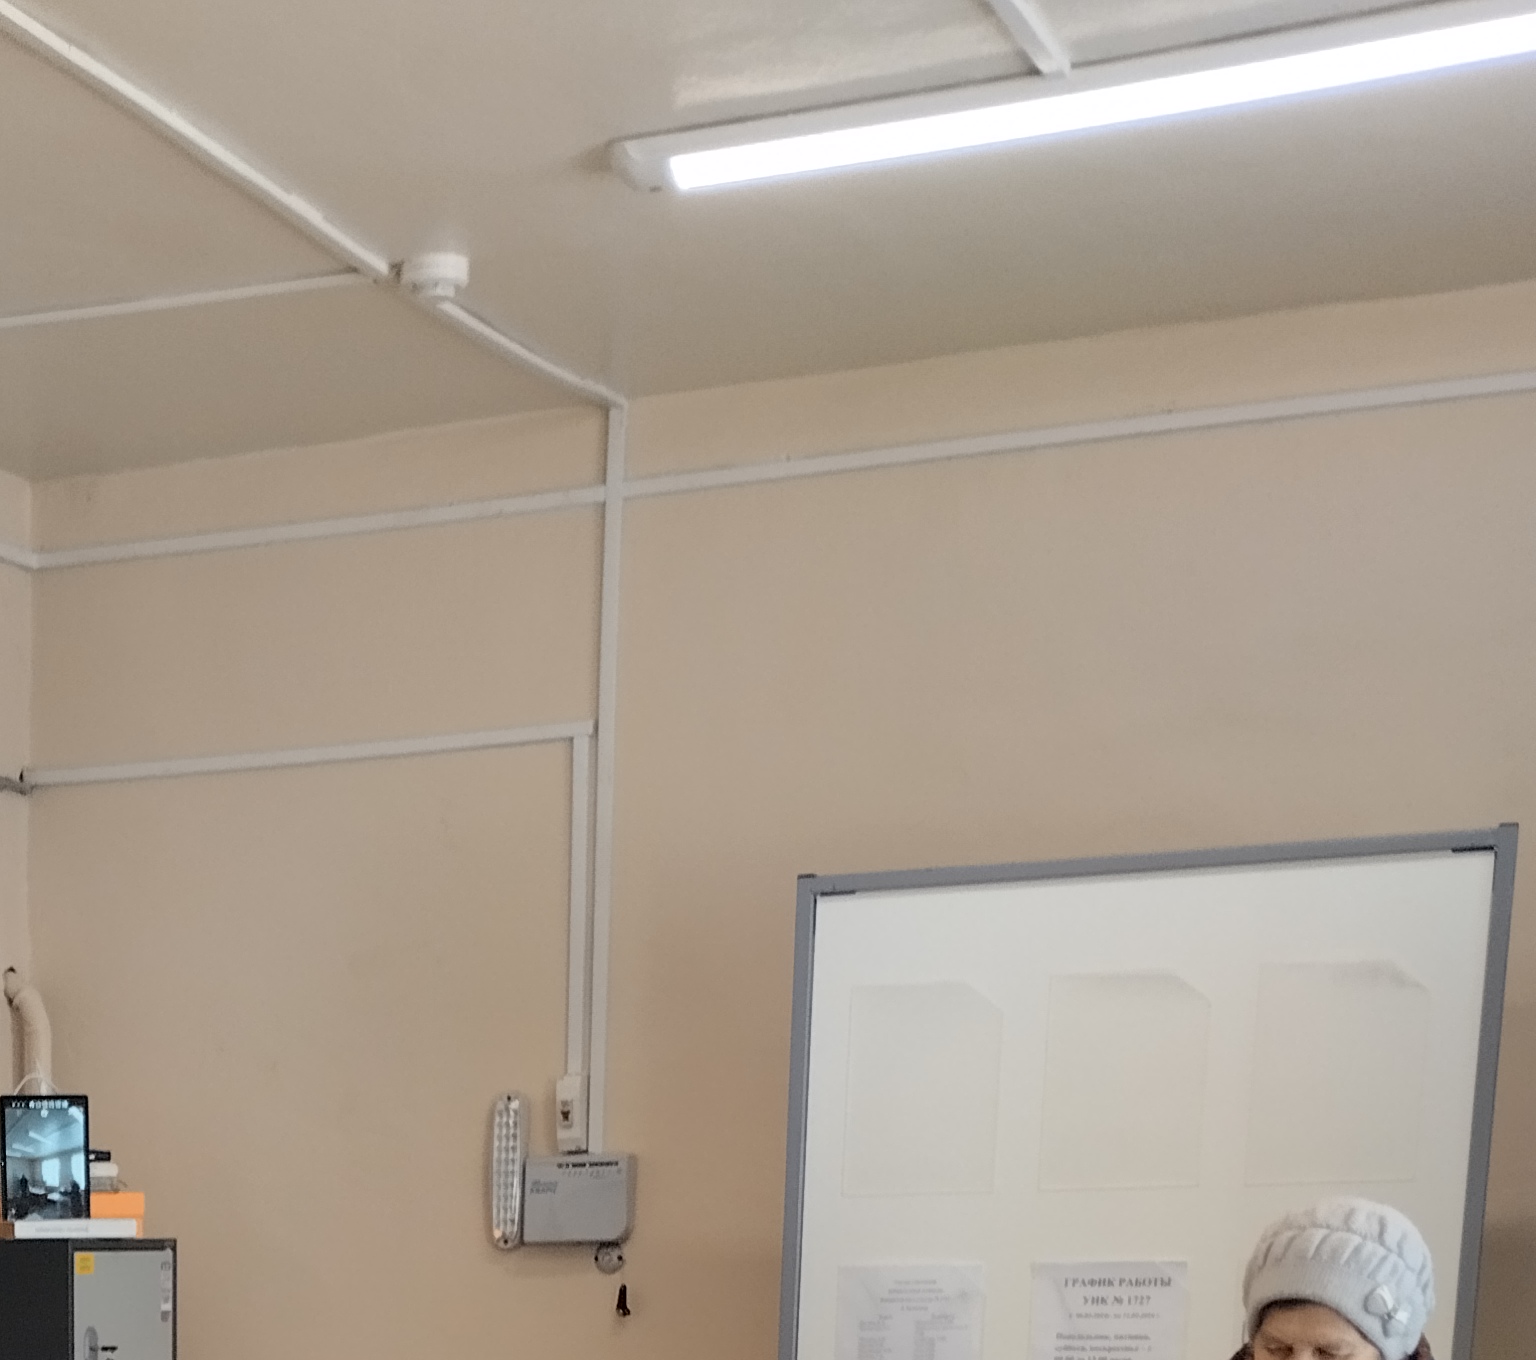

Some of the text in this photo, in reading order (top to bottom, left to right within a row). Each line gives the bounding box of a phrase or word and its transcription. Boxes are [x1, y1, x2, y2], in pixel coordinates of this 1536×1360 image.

[1064, 1276, 1172, 1288] ГРАФИК РАБОТЫ
[1083, 1295, 1108, 1306] УИК
